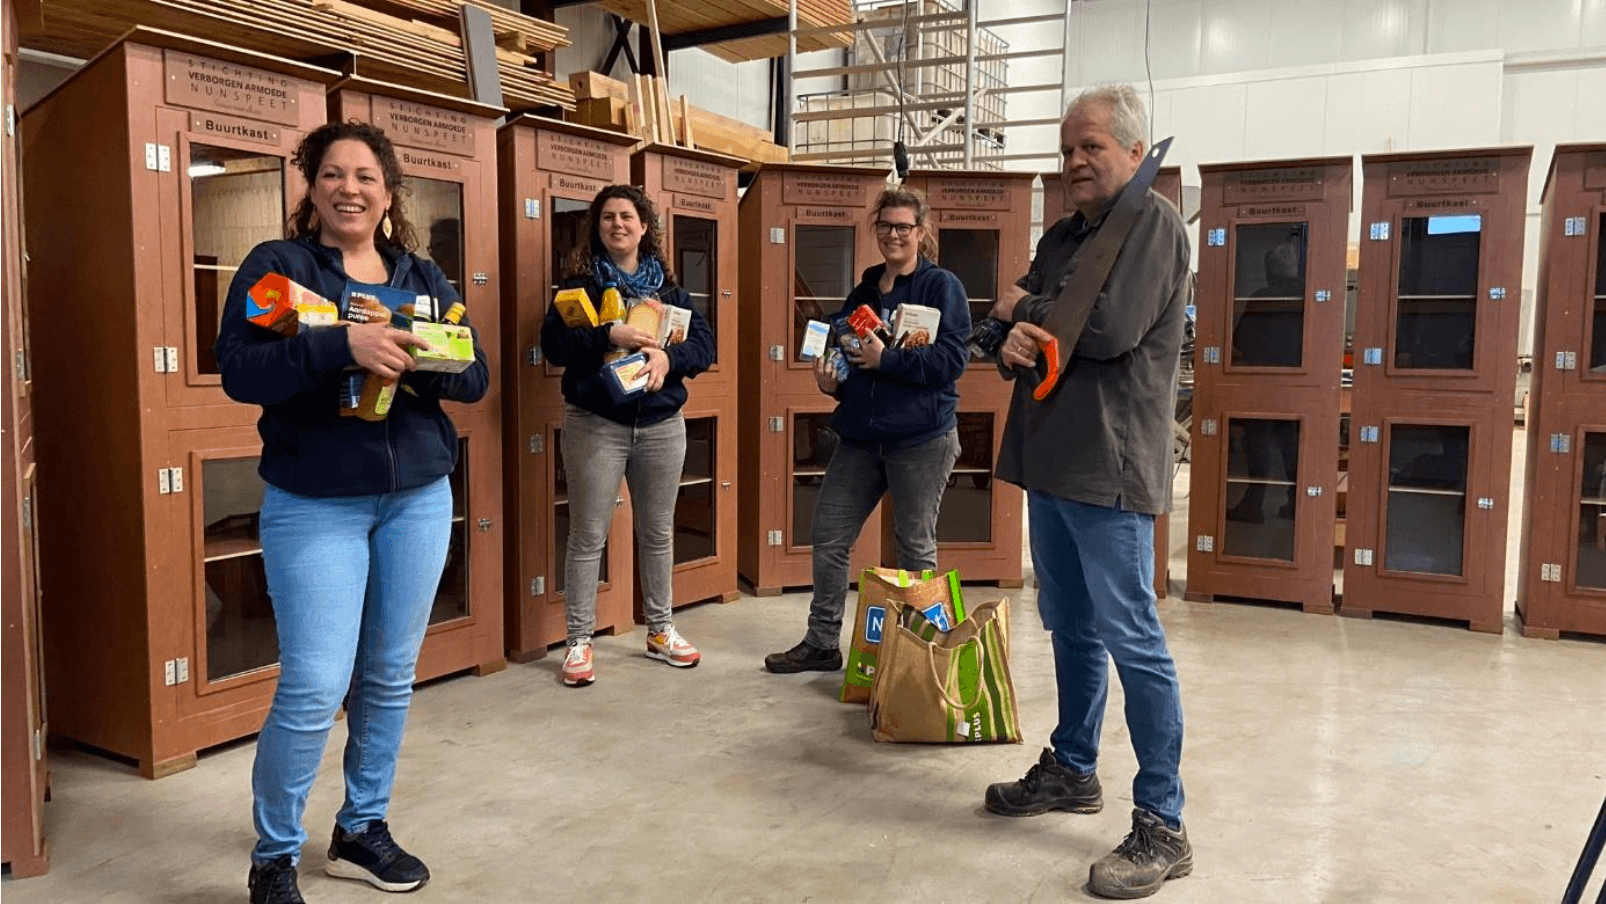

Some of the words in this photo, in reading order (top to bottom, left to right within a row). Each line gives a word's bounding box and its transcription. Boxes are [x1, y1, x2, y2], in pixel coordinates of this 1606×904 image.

[188, 59, 287, 87] STICHTING
[188, 71, 243, 89] VERBORGEN
[245, 83, 287, 99] ARMOEDE
[190, 83, 287, 110] NUNSPEET
[390, 102, 467, 124] STICHTING
[390, 112, 432, 127] VERBORGEN
[433, 120, 466, 134] ARMOEDE
[205, 119, 269, 140] Buurtkast
[391, 122, 466, 143] NUNSPEET
[550, 144, 582, 156] VERBORGEN
[403, 153, 452, 170] Buurtkast
[560, 178, 597, 192] Buurtkast
[806, 209, 846, 218] Buurtkast
[1248, 206, 1297, 215] Buurtkast
[1416, 199, 1470, 209] Buurtkast
[949, 213, 989, 221] Buurtkast
[973, 711, 982, 738] PLUS
